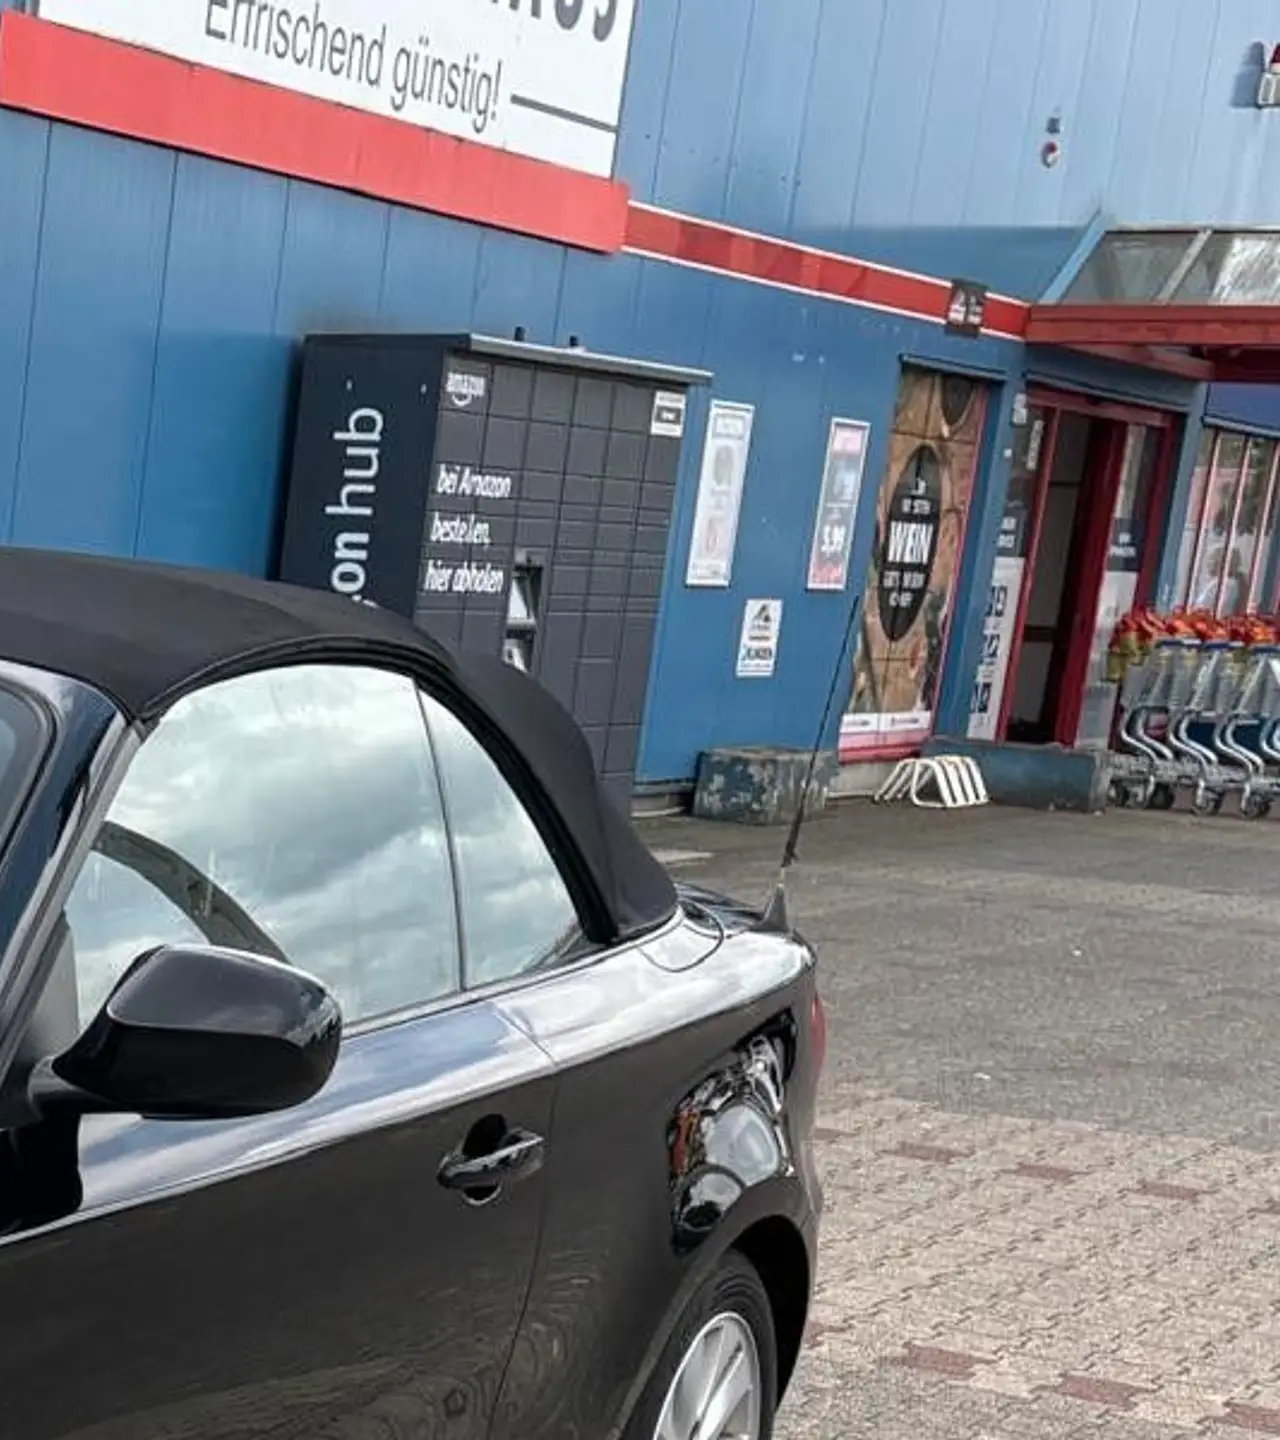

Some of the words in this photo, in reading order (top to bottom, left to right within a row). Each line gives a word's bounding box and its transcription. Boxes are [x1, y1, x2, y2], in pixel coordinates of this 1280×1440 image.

[390, 35, 503, 134] günstig!
[324, 407, 384, 516] hub
[437, 463, 459, 495] bei
[458, 466, 512, 498] Amazon
[887, 519, 934, 565] WEIN
[424, 559, 453, 592] hier
[452, 561, 504, 593] abholen
